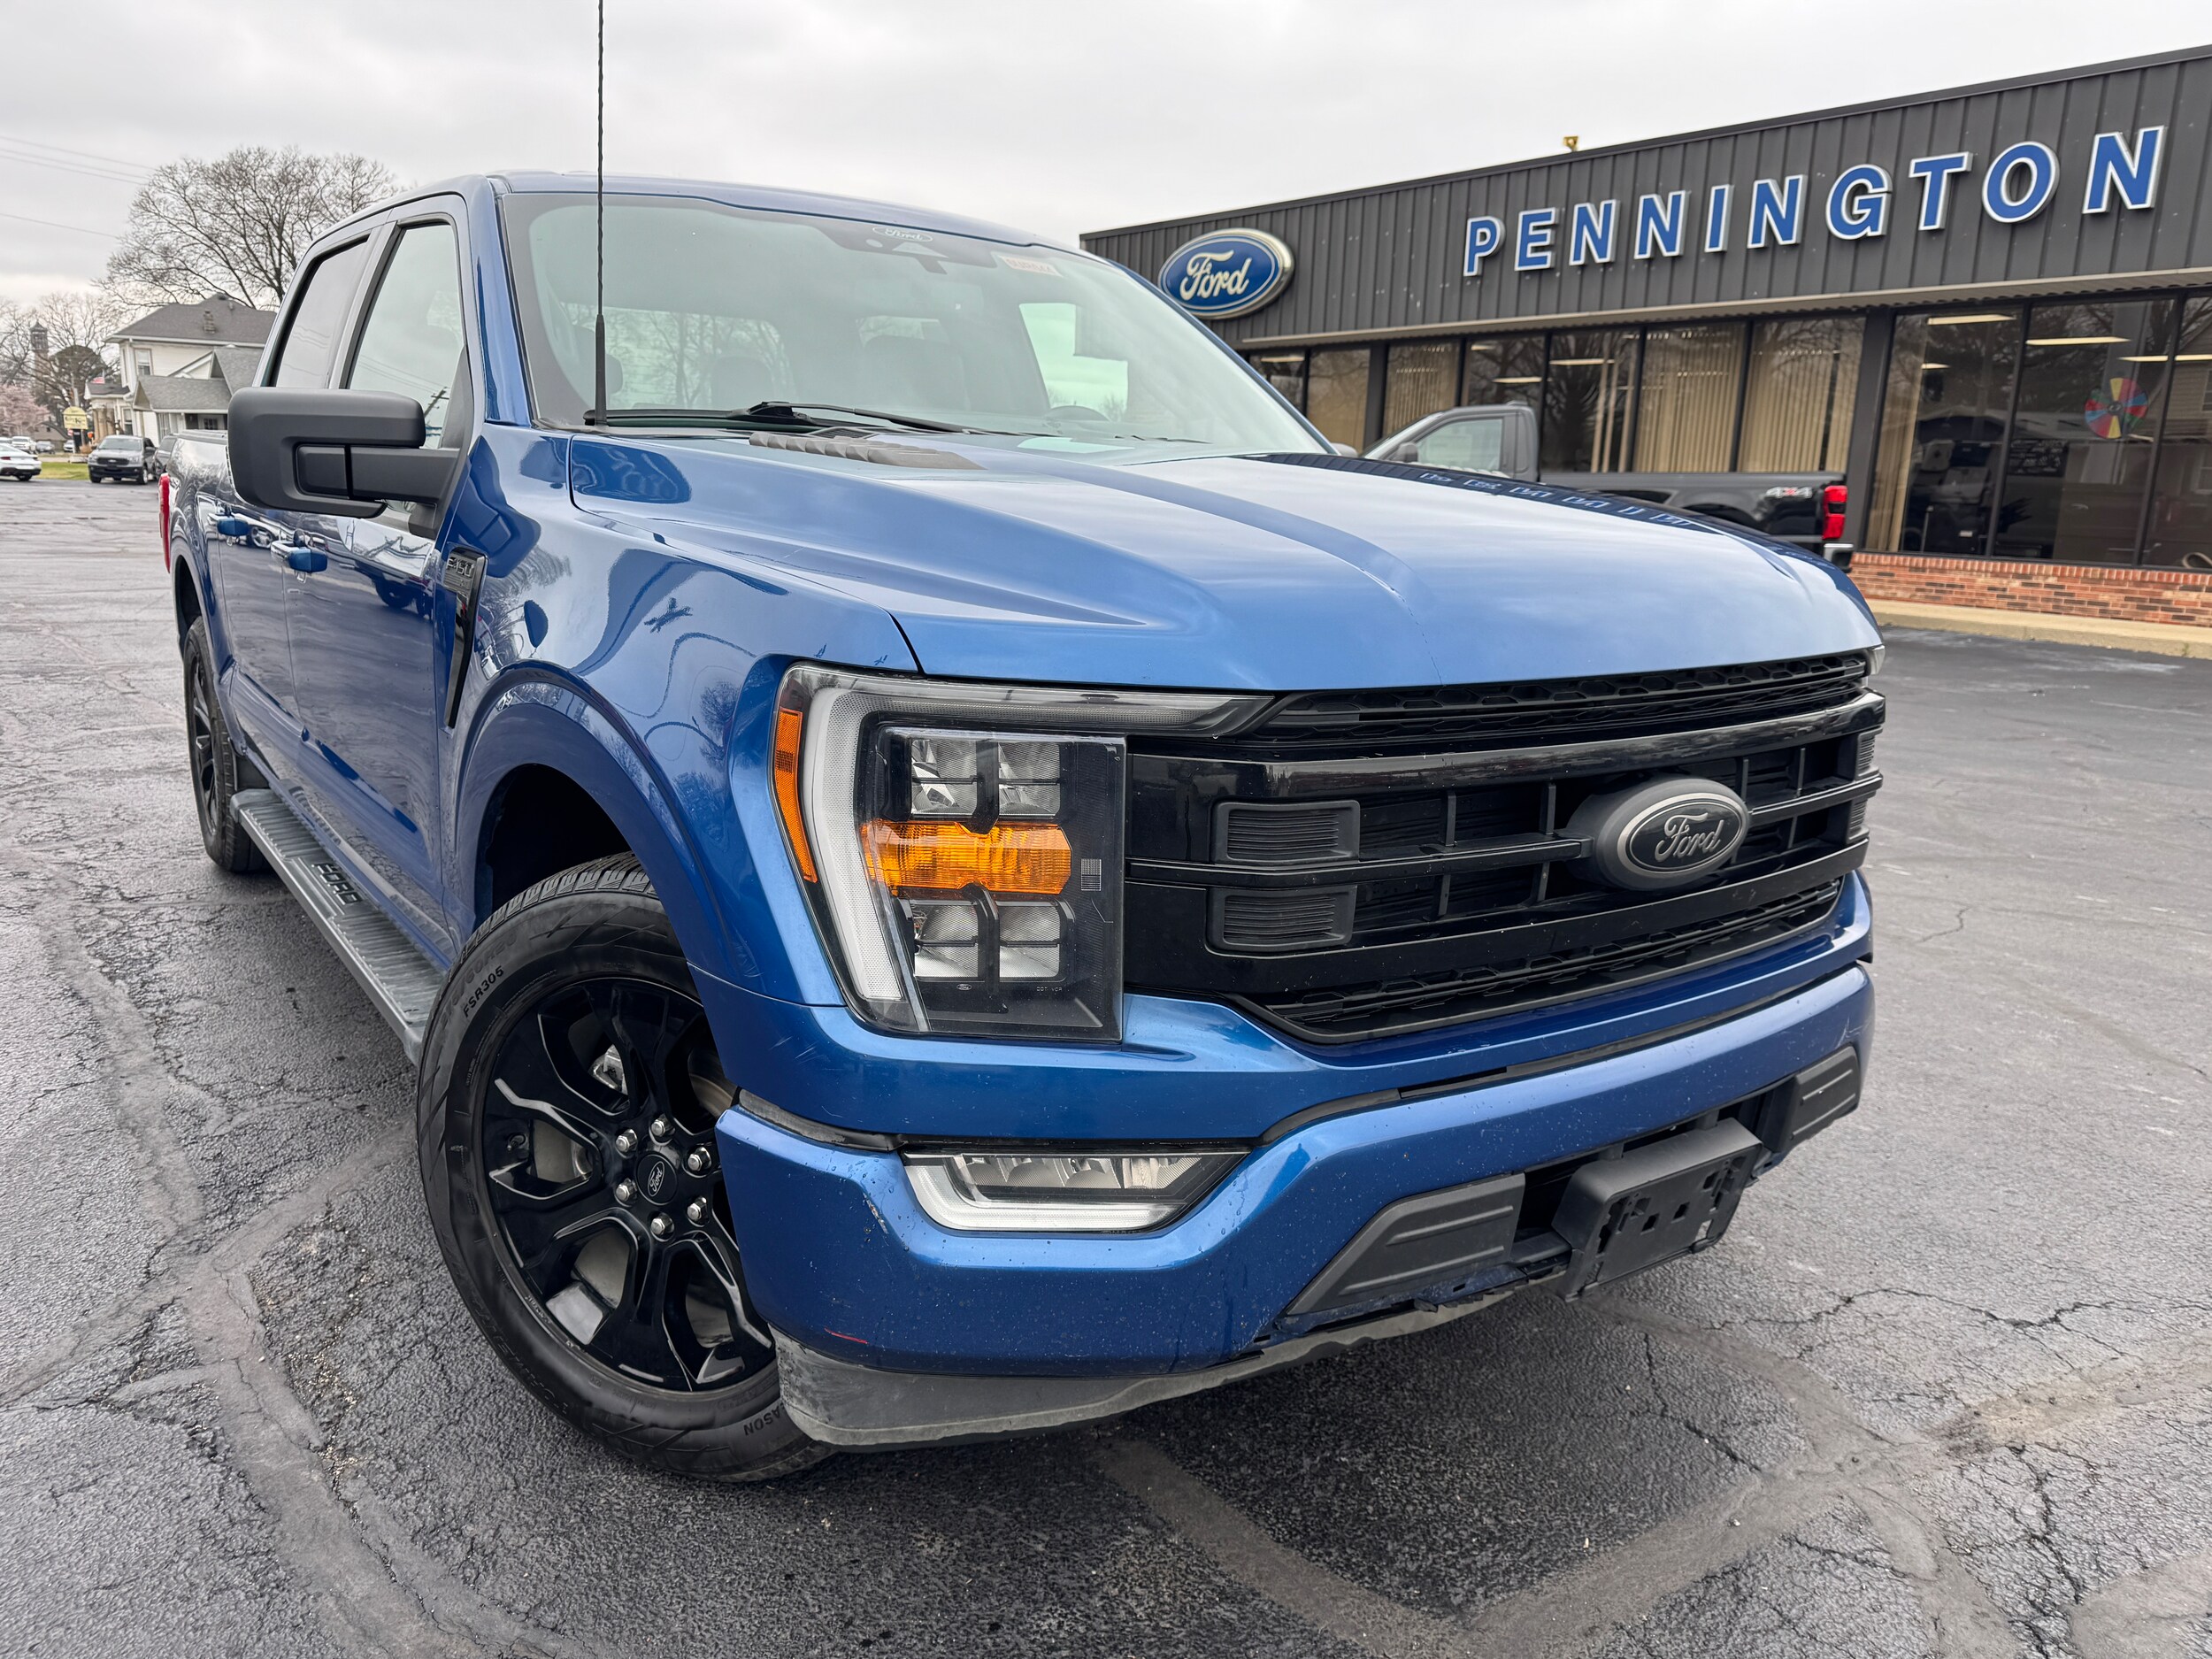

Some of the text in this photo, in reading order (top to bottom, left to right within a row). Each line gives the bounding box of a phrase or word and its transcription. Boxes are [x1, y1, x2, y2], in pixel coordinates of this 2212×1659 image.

[1463, 125, 2167, 277] PENNINGTON
[1179, 250, 1253, 301] Ford
[1654, 812, 1725, 863] Ford
[463, 964, 505, 1018] FSR305
[649, 1166, 663, 1192] Ford
